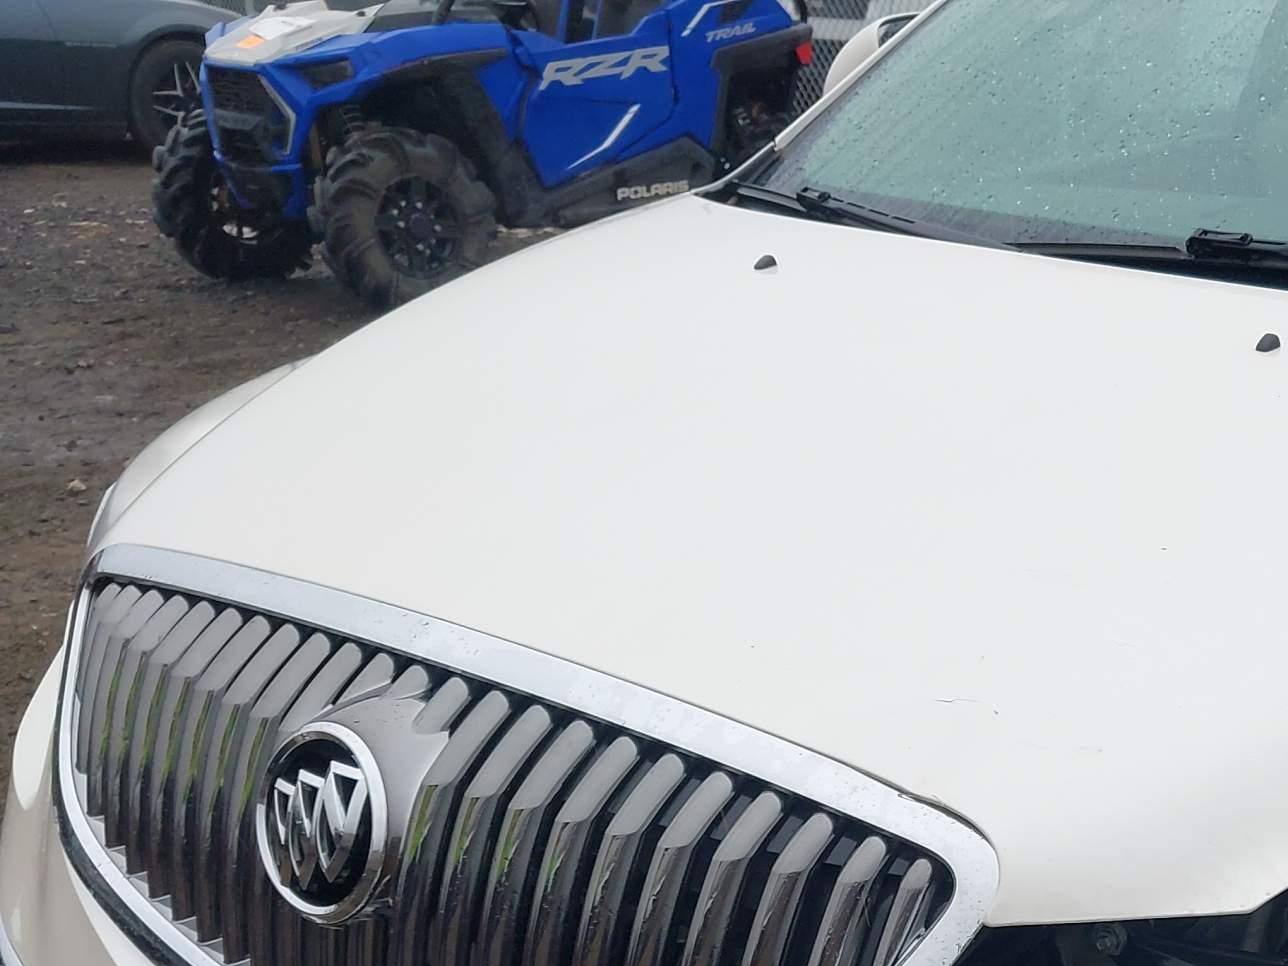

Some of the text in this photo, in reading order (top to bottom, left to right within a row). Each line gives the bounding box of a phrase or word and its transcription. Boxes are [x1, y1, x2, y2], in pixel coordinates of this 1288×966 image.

[705, 22, 757, 42] TRAIL
[539, 46, 670, 91] RZR
[616, 180, 689, 201] POLARIS
